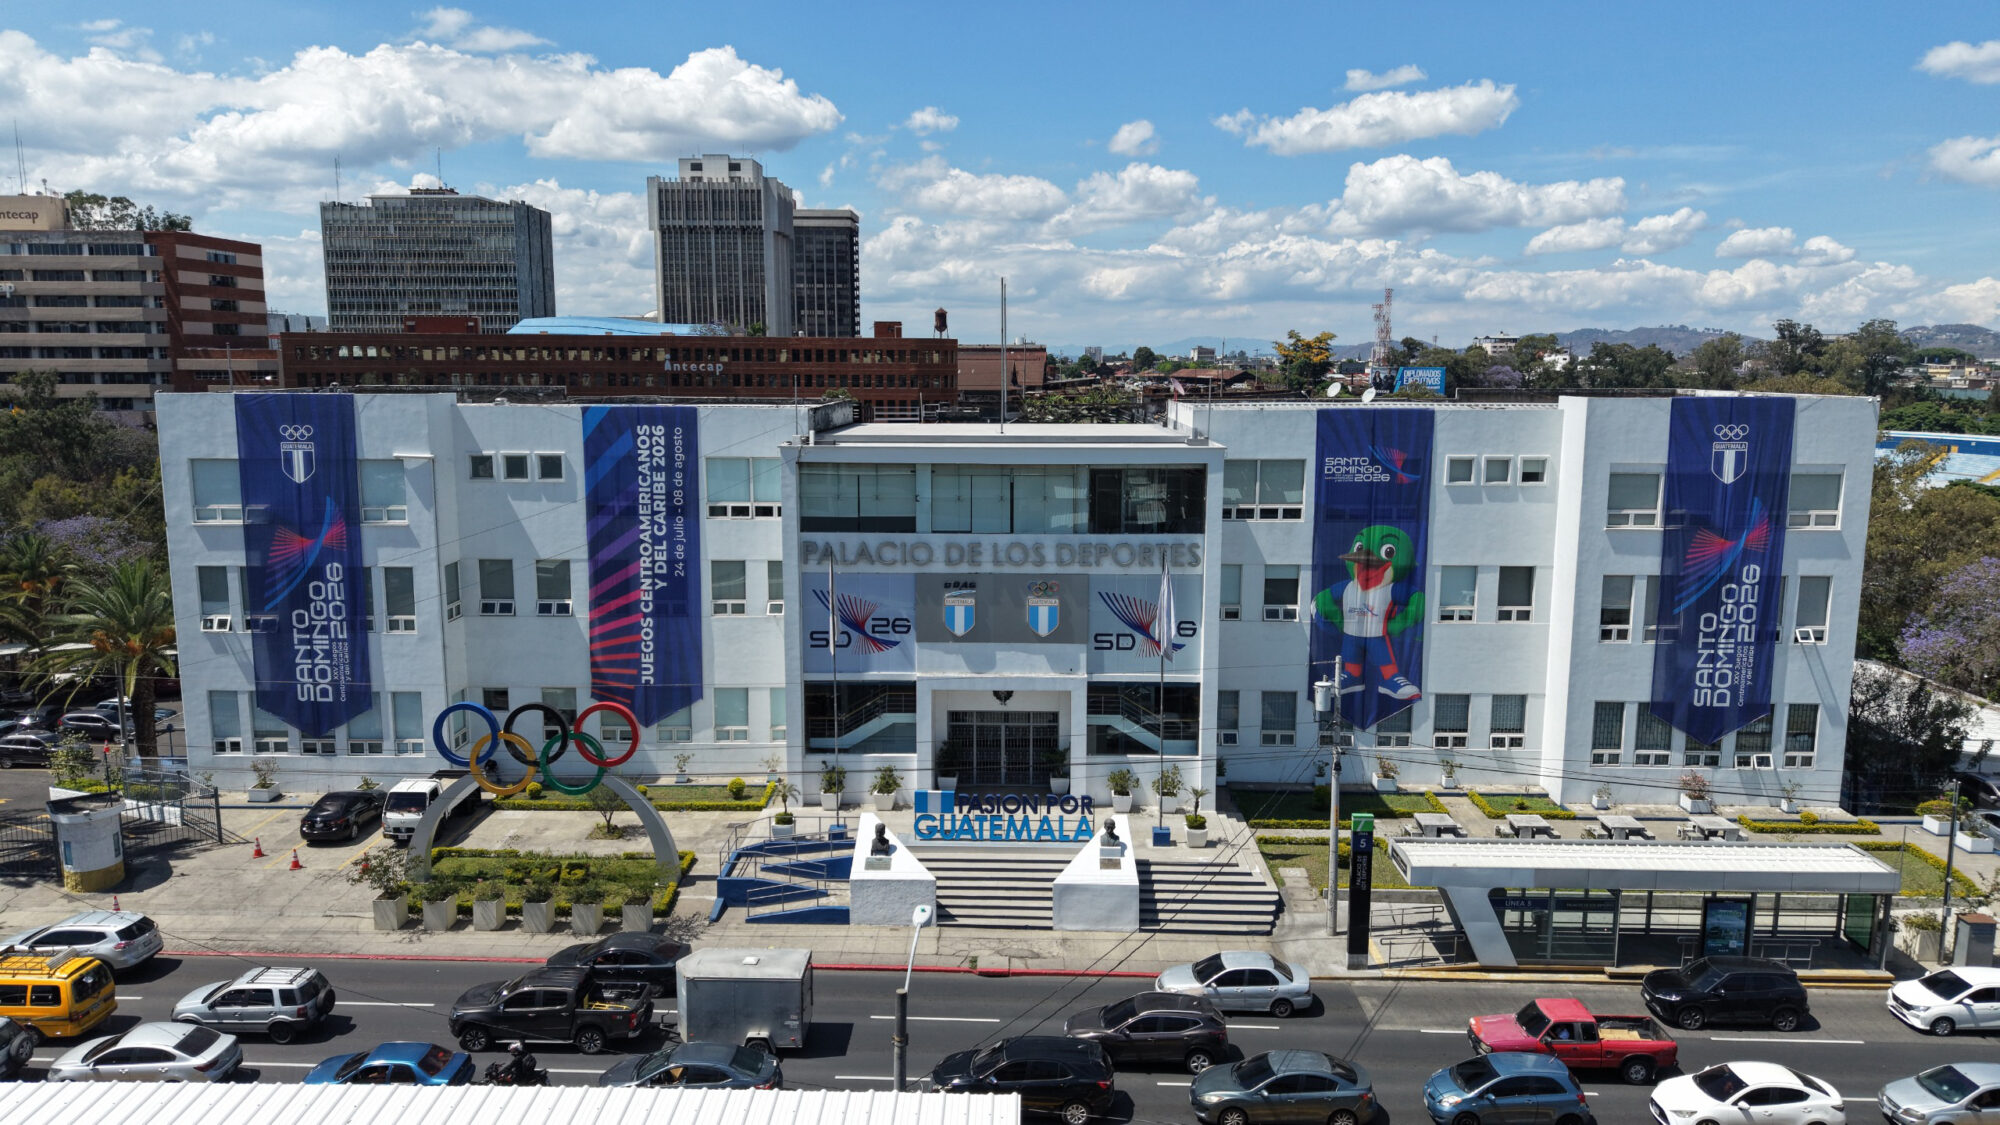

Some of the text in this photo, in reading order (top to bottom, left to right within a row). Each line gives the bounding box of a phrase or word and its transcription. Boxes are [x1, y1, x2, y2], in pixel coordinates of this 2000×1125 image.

[0, 211, 39, 224] ntecap
[673, 427, 685, 469] agosto
[1324, 465, 1382, 474] DOMINGO
[1325, 457, 1369, 465] SANTO
[673, 472, 684, 487] de
[1354, 473, 1390, 482] 2026
[652, 425, 667, 590] Y DEL CARIBE 2026
[674, 489, 684, 506] 08
[673, 516, 686, 543] julio
[637, 424, 654, 685] JUEGOS CENTROAMERICANOS
[674, 544, 684, 559] de
[802, 540, 1202, 568] PALACIO DE LOS DEPORTES
[674, 562, 684, 577] 24
[326, 562, 348, 639] 2026
[1737, 564, 1761, 643] 2026
[871, 617, 912, 635] 26
[309, 580, 333, 702] DOMINGO
[1094, 633, 1136, 651] SD
[1712, 583, 1739, 707] DOMINGO
[291, 609, 315, 702] SANTO
[1693, 612, 1718, 707] SANTO
[1735, 646, 1743, 670] Juegos
[1738, 646, 1748, 707] Centroamericanos
[958, 793, 1094, 815] PASION POR
[913, 814, 1095, 842] GUATEMALA
[1359, 838, 1367, 848] 5
